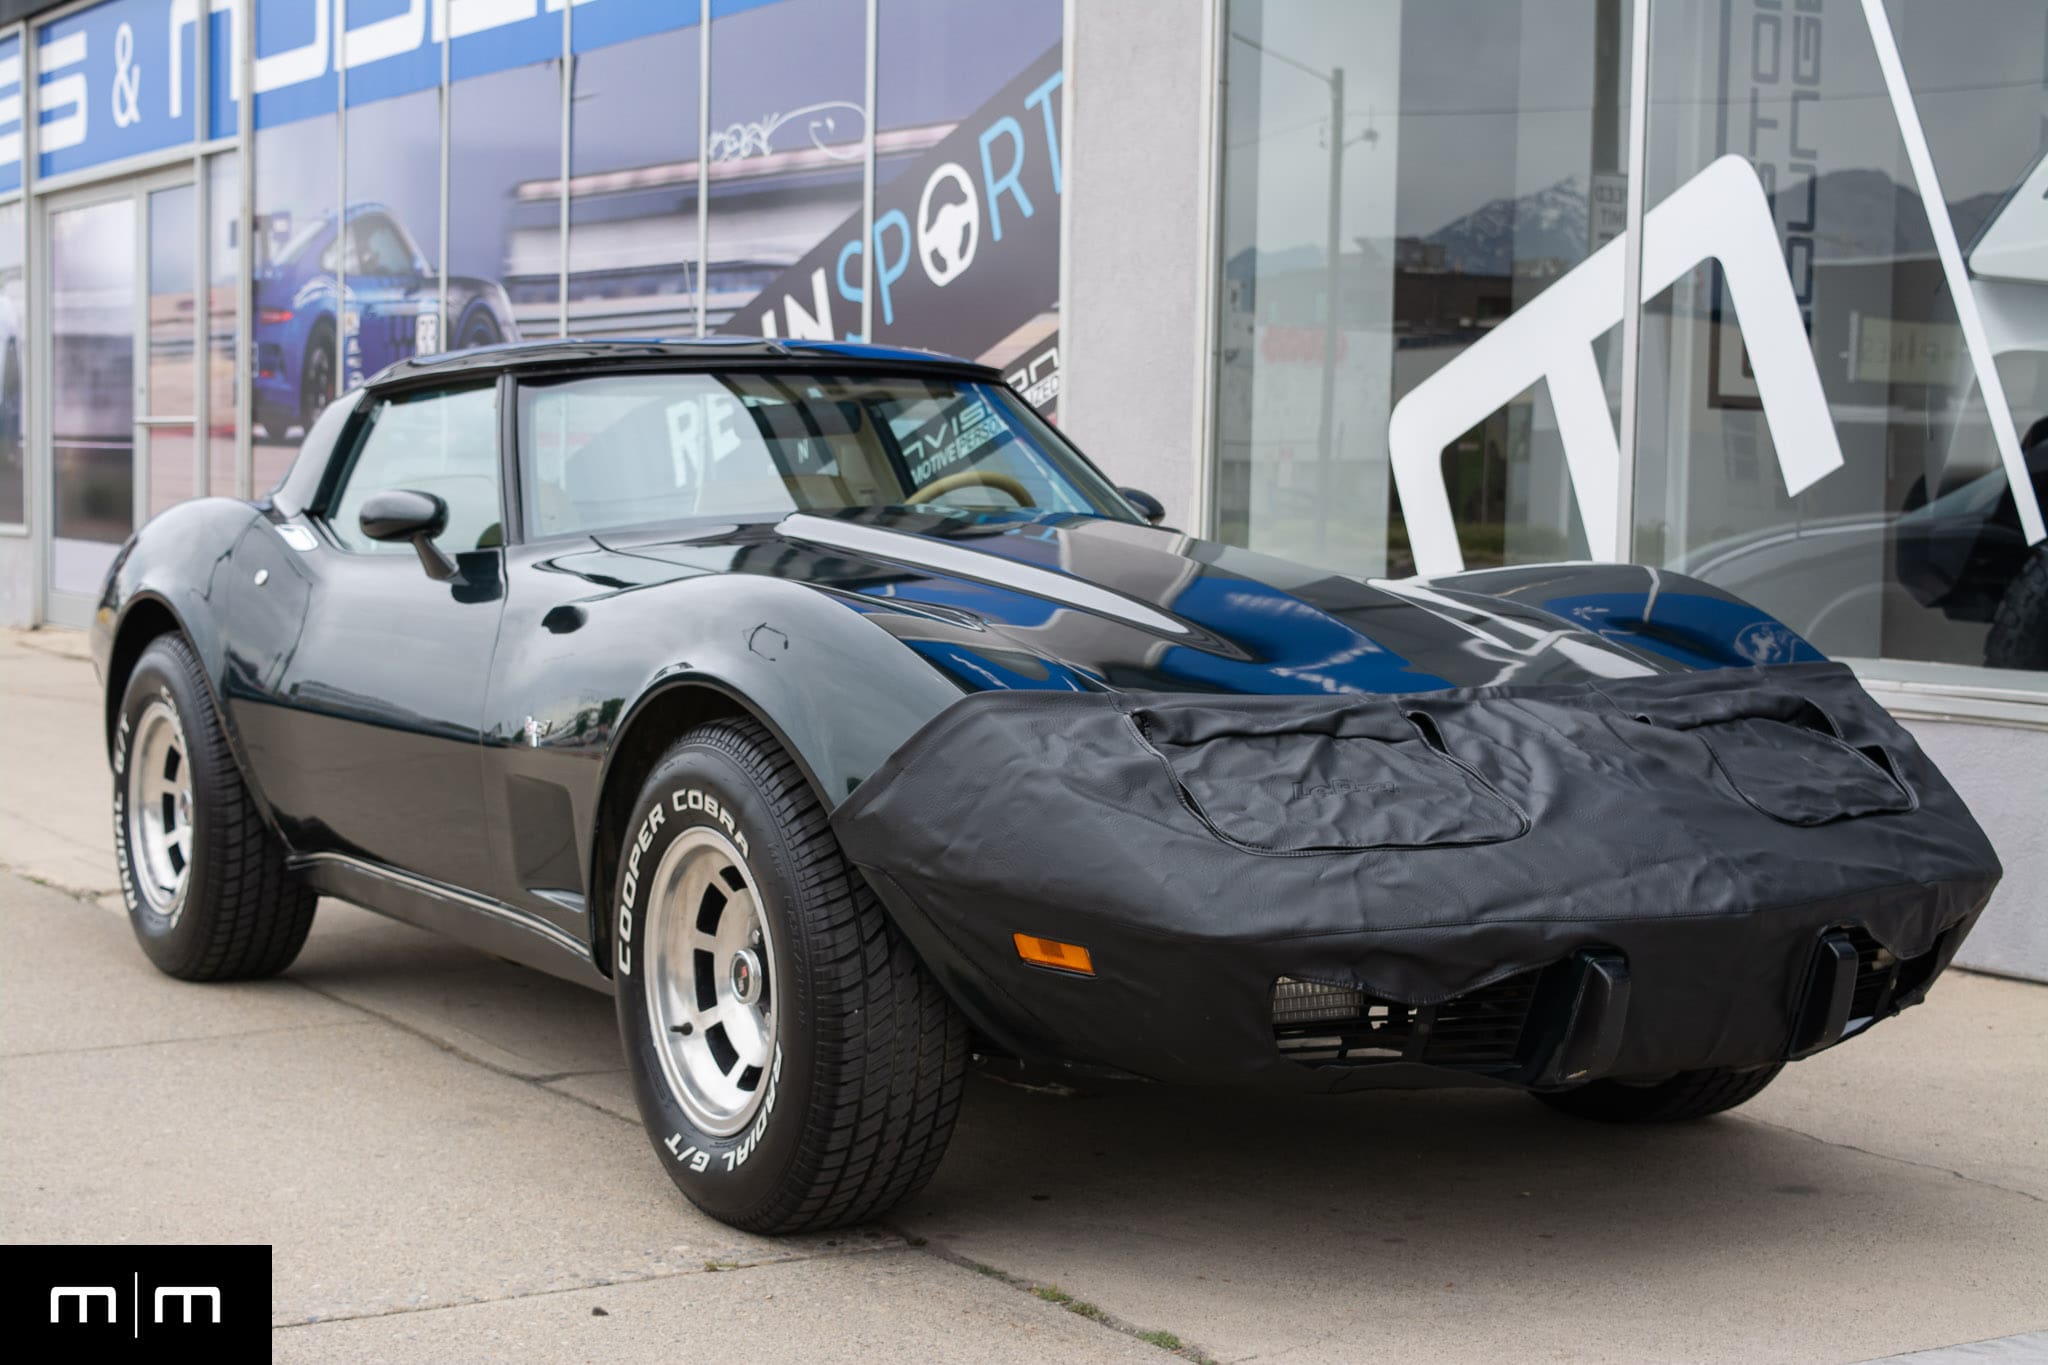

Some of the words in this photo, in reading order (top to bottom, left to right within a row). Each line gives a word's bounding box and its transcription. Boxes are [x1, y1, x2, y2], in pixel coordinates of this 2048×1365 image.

[111, 22, 141, 128] &
[618, 802, 666, 976] COOPER
[672, 789, 749, 859] COBRA
[664, 1132, 711, 1173] G/T
[721, 1040, 783, 1172] RADIAL
